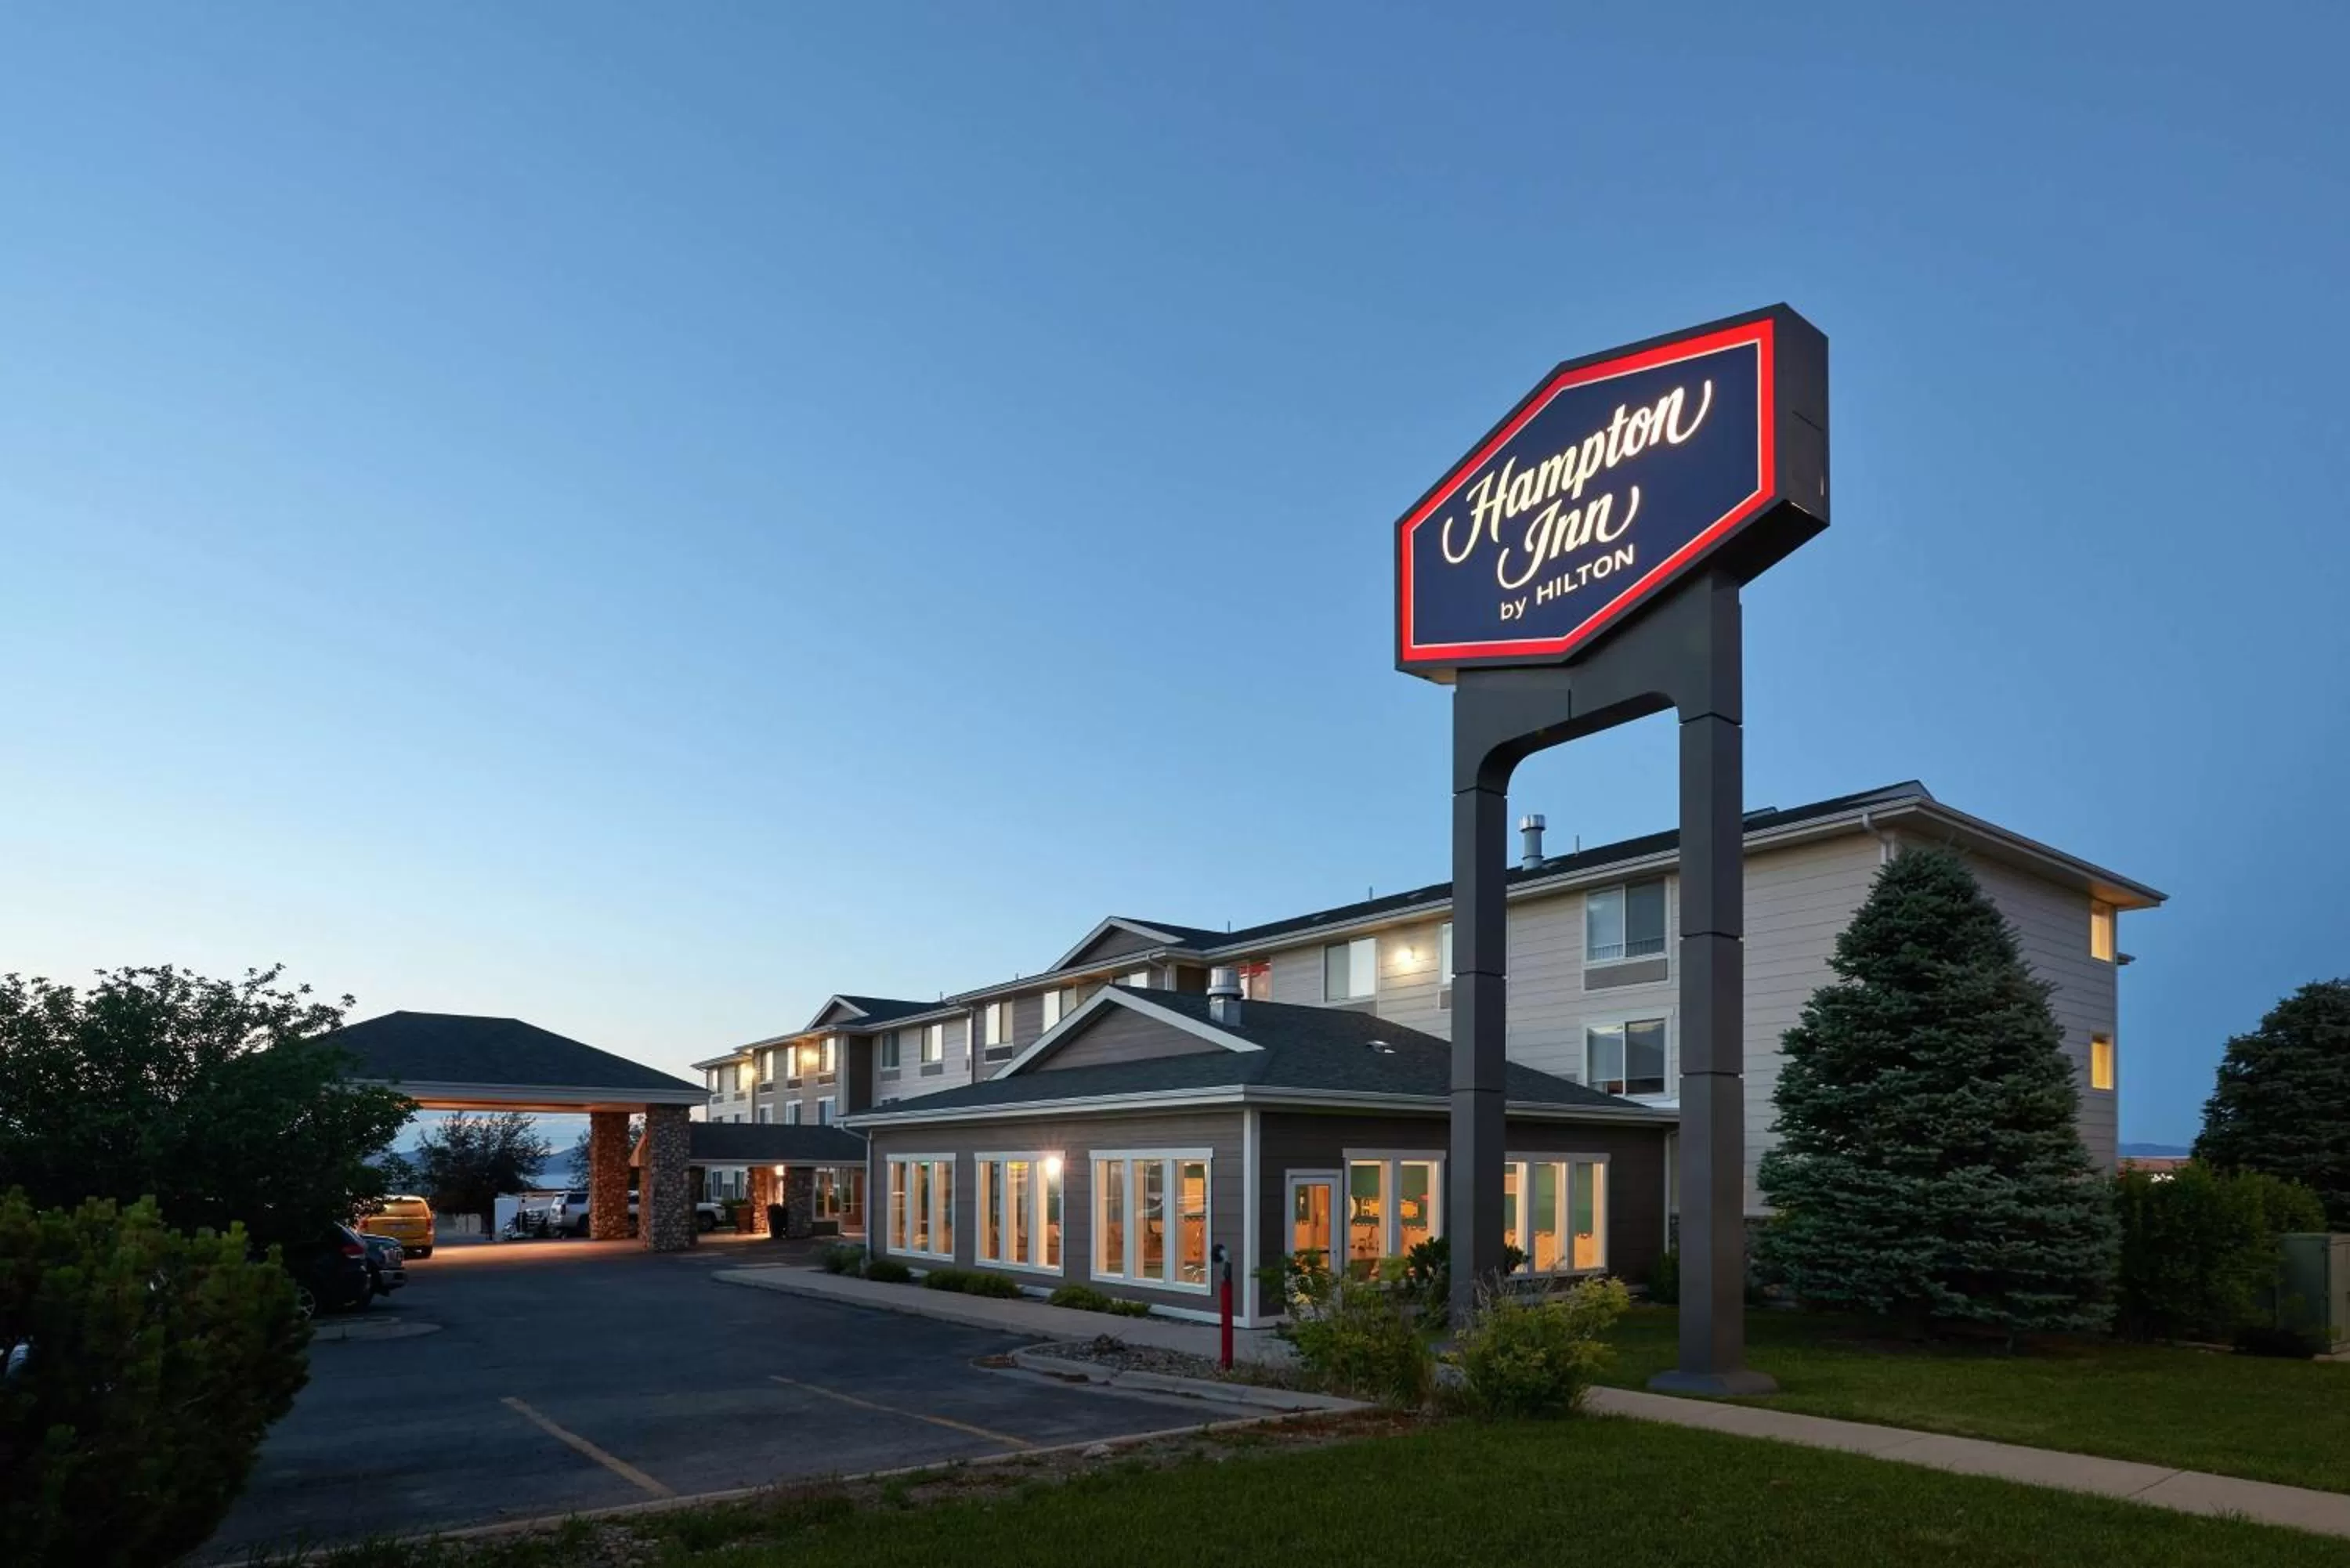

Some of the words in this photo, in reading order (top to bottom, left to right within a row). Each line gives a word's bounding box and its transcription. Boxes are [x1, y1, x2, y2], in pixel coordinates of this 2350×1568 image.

[1442, 380, 1712, 564] Hampton
[1497, 486, 1640, 590] Inn
[1500, 597, 1528, 621] by
[1536, 544, 1635, 605] HILTON
